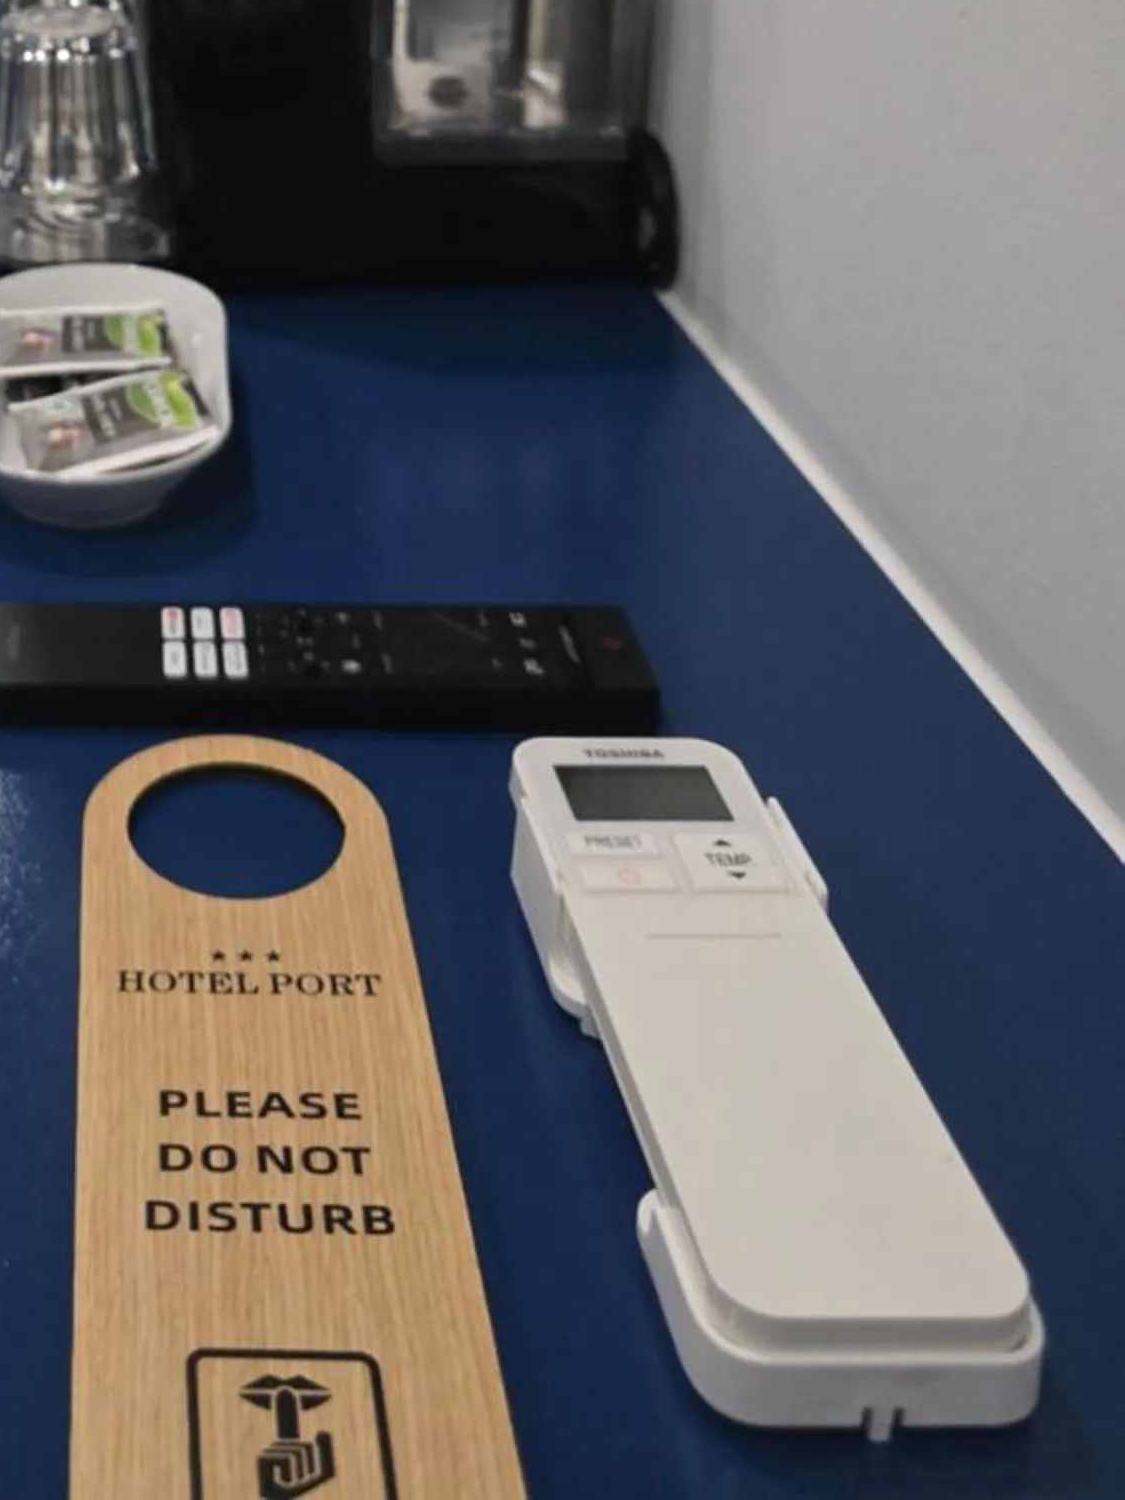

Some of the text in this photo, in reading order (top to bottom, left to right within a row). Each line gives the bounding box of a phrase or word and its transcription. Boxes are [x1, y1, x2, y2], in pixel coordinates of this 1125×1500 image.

[583, 748, 666, 760] TOSHIBA
[583, 833, 644, 849] PRESET
[704, 851, 752, 867] TEMP
[118, 970, 382, 997] HOTEL PORT
[158, 1089, 363, 1120] PLEASE
[158, 1143, 371, 1176] DO NOT
[144, 1199, 396, 1236] DISTURB
